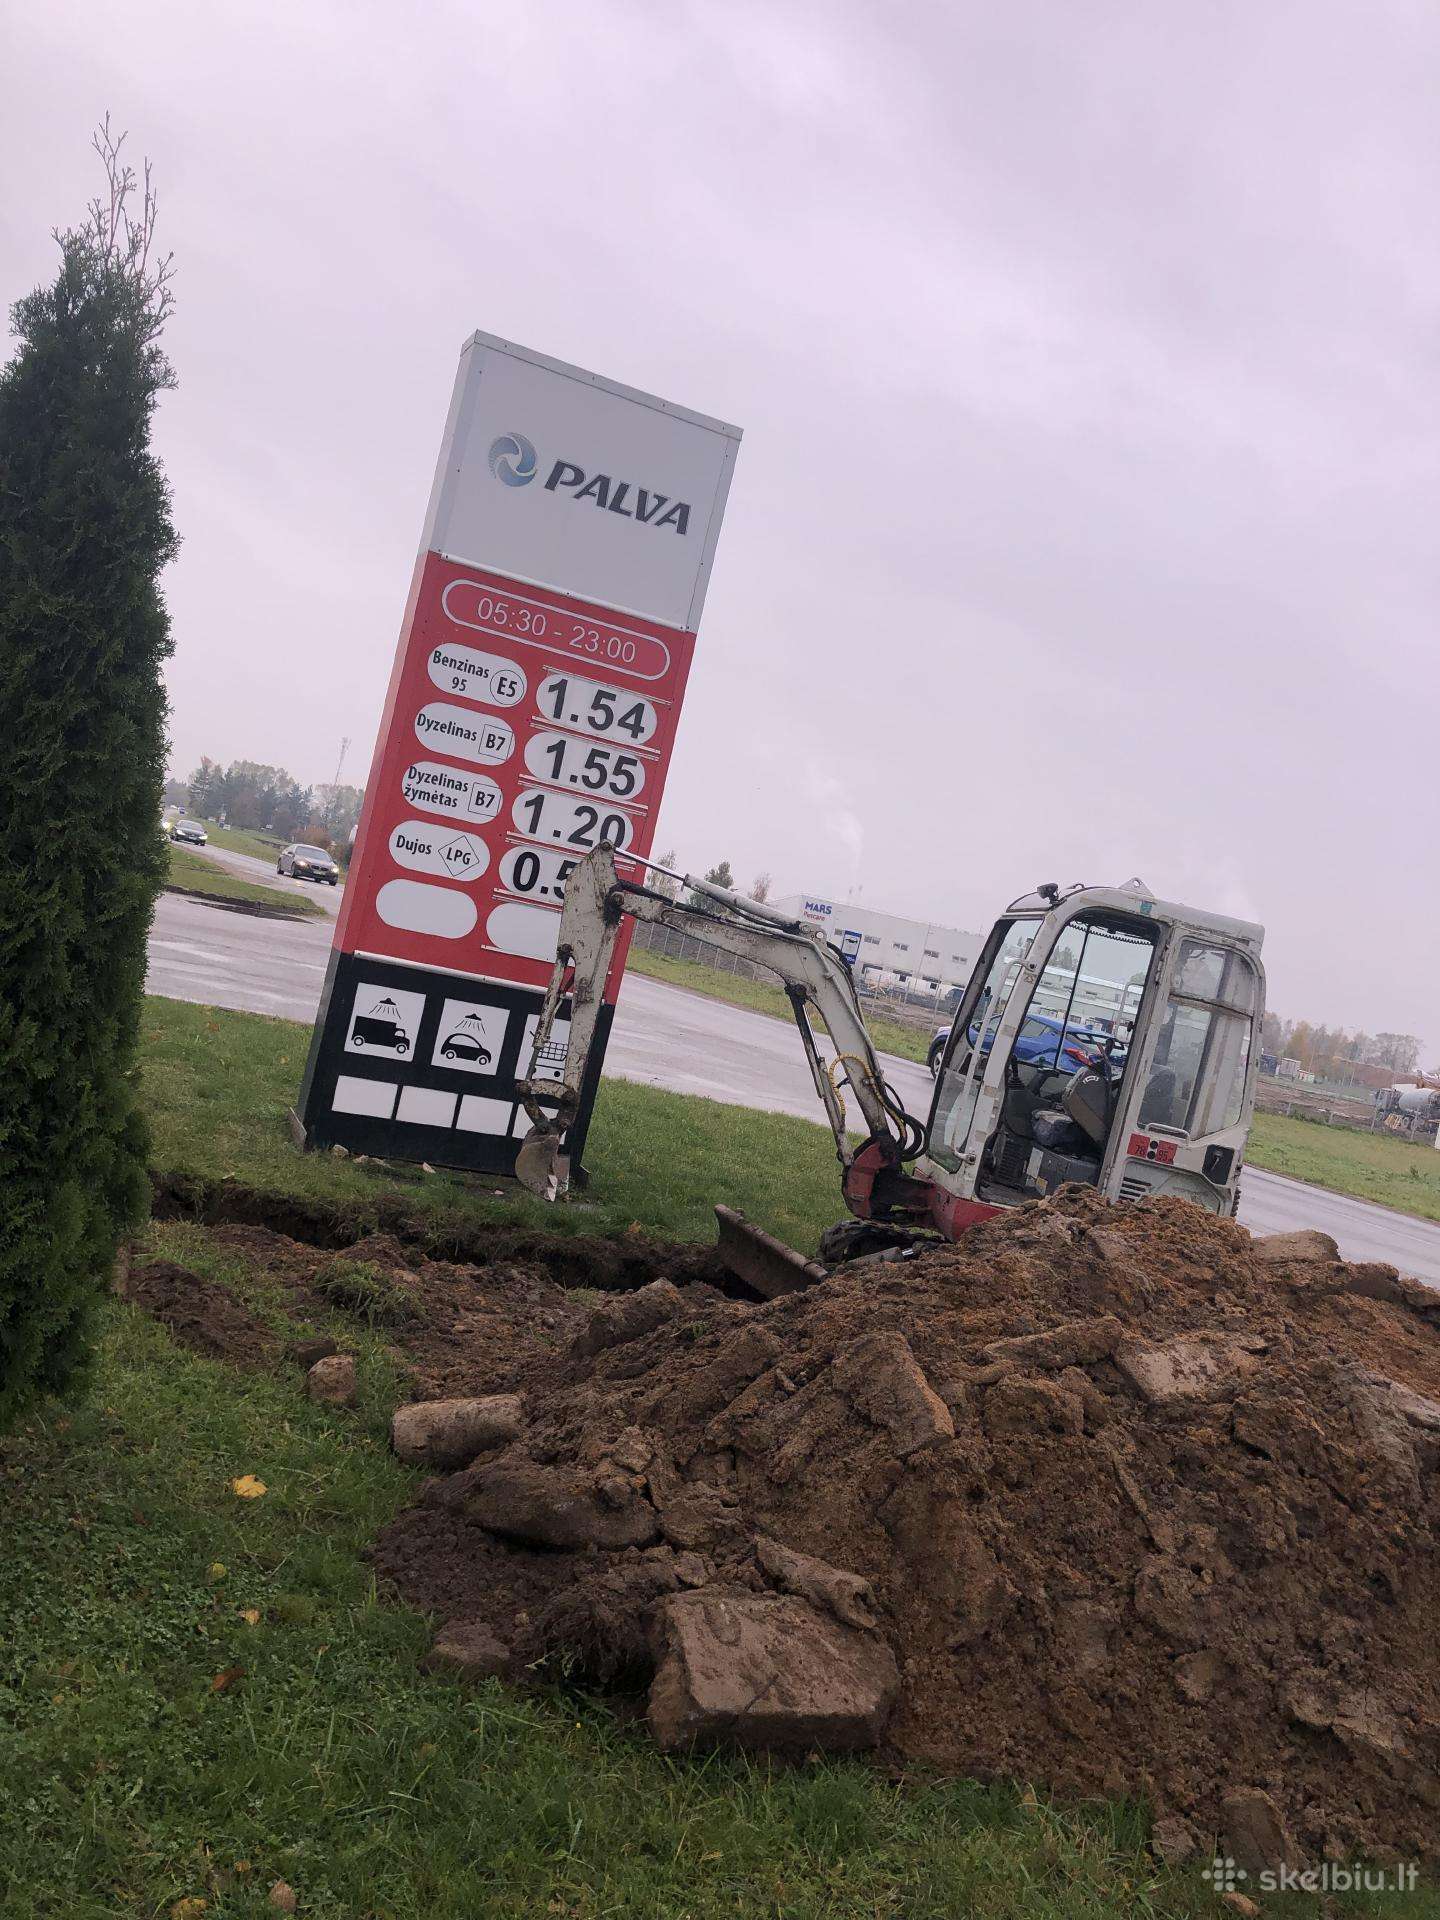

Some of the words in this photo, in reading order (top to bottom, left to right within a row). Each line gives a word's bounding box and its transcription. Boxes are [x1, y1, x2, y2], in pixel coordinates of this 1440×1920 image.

[544, 459, 691, 535] PALVA
[476, 597, 546, 635] 05:30
[569, 625, 636, 662] 23:00
[433, 650, 490, 678] Benzinas
[451, 677, 467, 691] 95
[496, 676, 518, 697] E5
[547, 678, 646, 739] 1.54
[416, 713, 477, 741] Dyzelinas
[485, 733, 506, 751] B7
[407, 765, 469, 792] Dyzelinas
[546, 739, 639, 796] 1.55
[404, 784, 458, 808] žymėtas
[474, 791, 495, 808] B7
[524, 794, 626, 849] 1.20
[396, 834, 432, 855] Dujos
[446, 847, 472, 865] LPG
[804, 901, 832, 915] MARS
